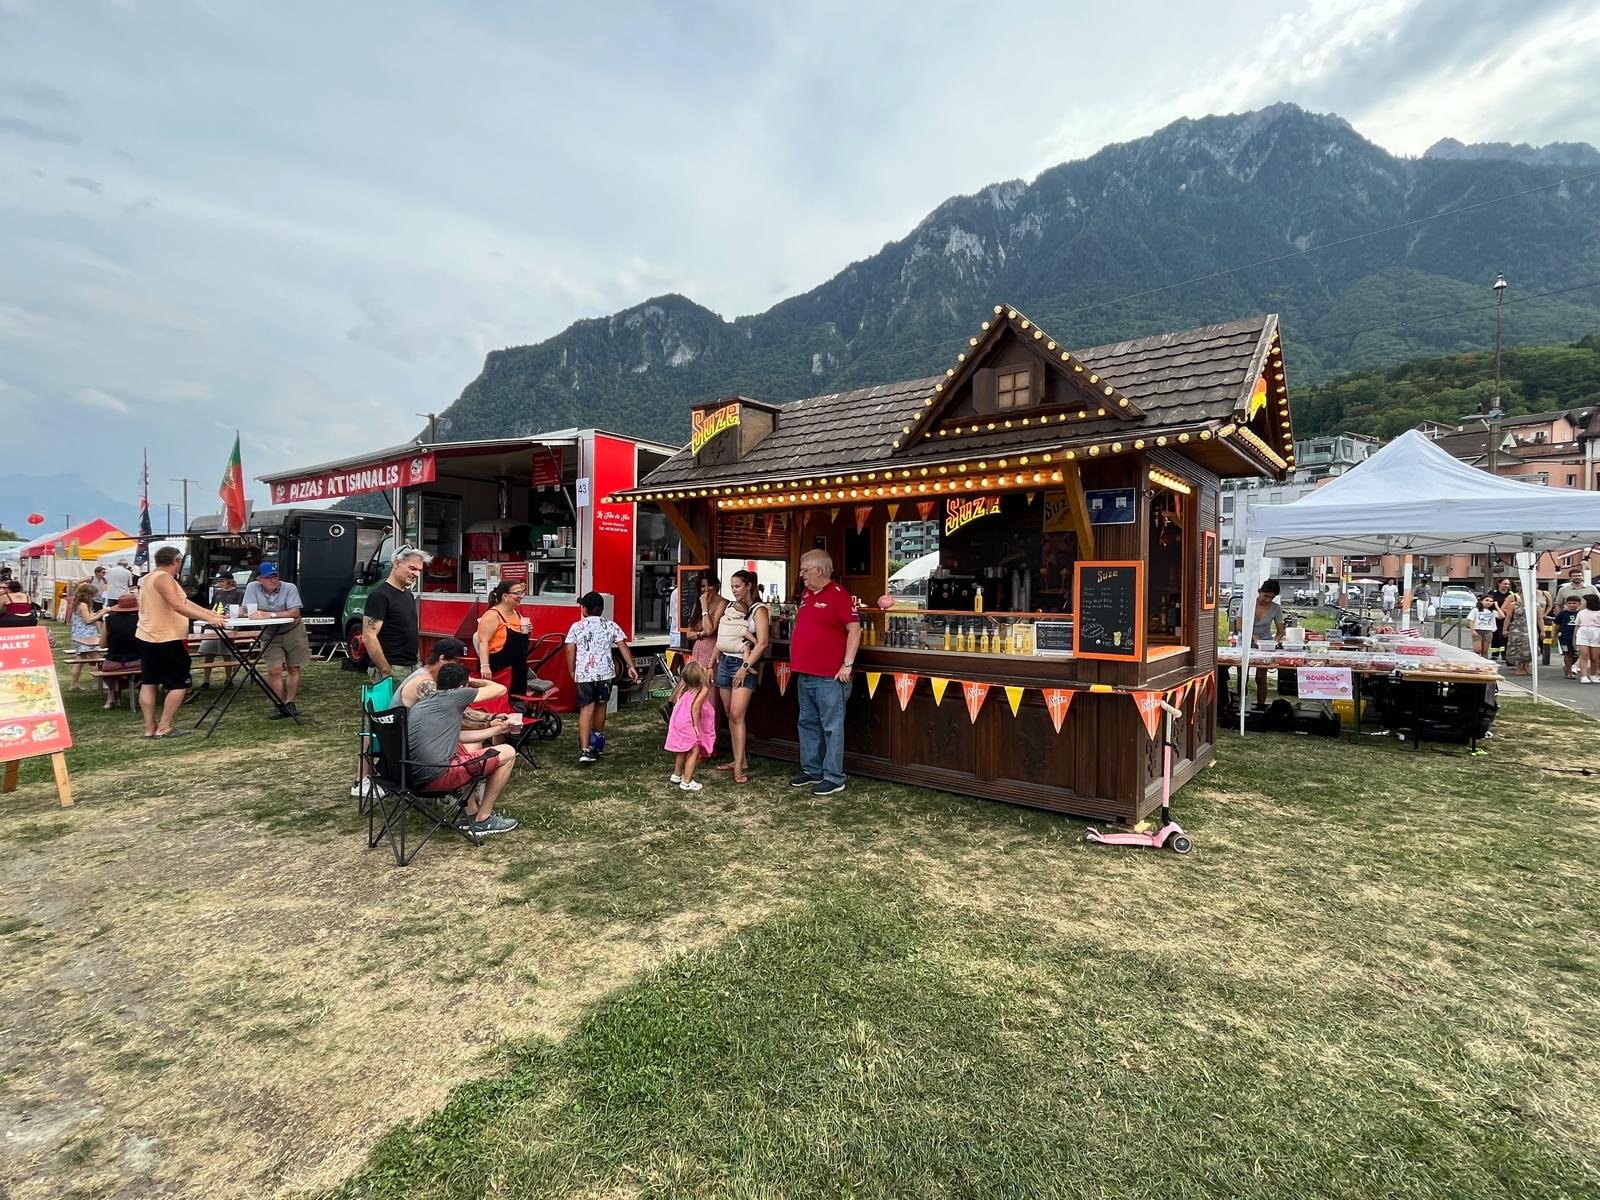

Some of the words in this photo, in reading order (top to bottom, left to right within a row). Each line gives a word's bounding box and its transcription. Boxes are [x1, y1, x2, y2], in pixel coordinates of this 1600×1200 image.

[691, 402, 740, 457] Suze
[289, 479, 323, 500] PIZZAS
[578, 484, 587, 494] 43
